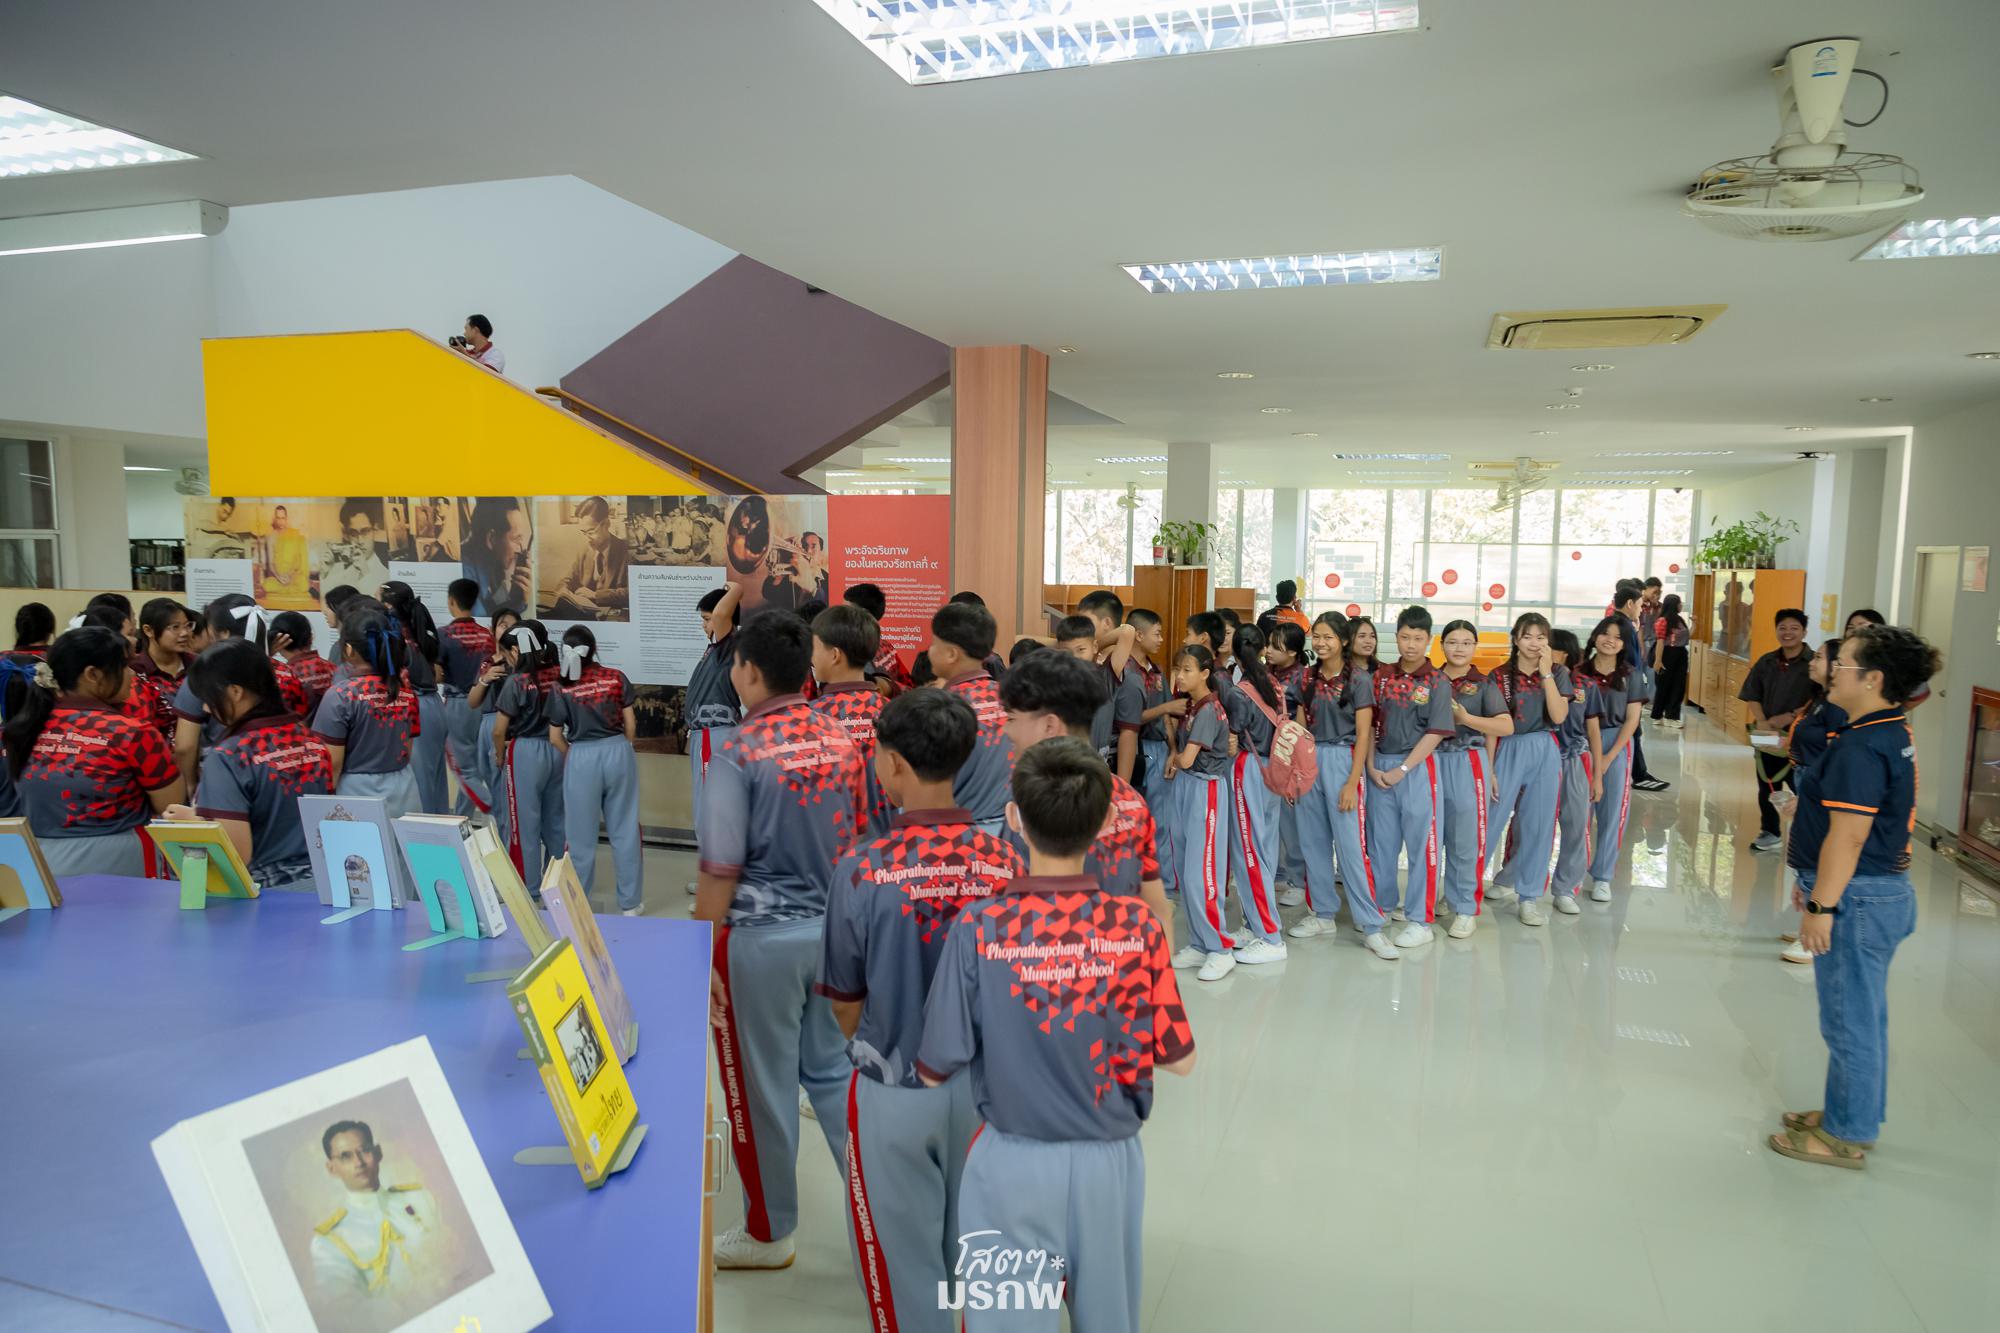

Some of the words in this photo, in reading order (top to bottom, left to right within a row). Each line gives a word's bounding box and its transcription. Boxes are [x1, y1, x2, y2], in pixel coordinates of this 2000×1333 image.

[845, 545, 909, 555] พระอัจฉริยภาพ
[845, 556, 928, 569] ของในหลวงรัชกาลที่
[1274, 720, 1306, 766] JUST
[874, 861, 968, 885] Phoprathapchang
[971, 860, 1014, 880] Wittayalai
[910, 882, 958, 900] Municipal
[959, 882, 994, 897] School
[986, 940, 1086, 963] Phoprathapchang
[1089, 936, 1145, 957] Wittayalai
[1020, 962, 1076, 984] Municipal
[1078, 959, 1115, 978] School
[725, 1066, 741, 1108] MUNICIPAL
[733, 1109, 748, 1144] COLLEGE
[865, 1243, 882, 1304] MUNICIPAL
[876, 1307, 891, 1333] COLL
